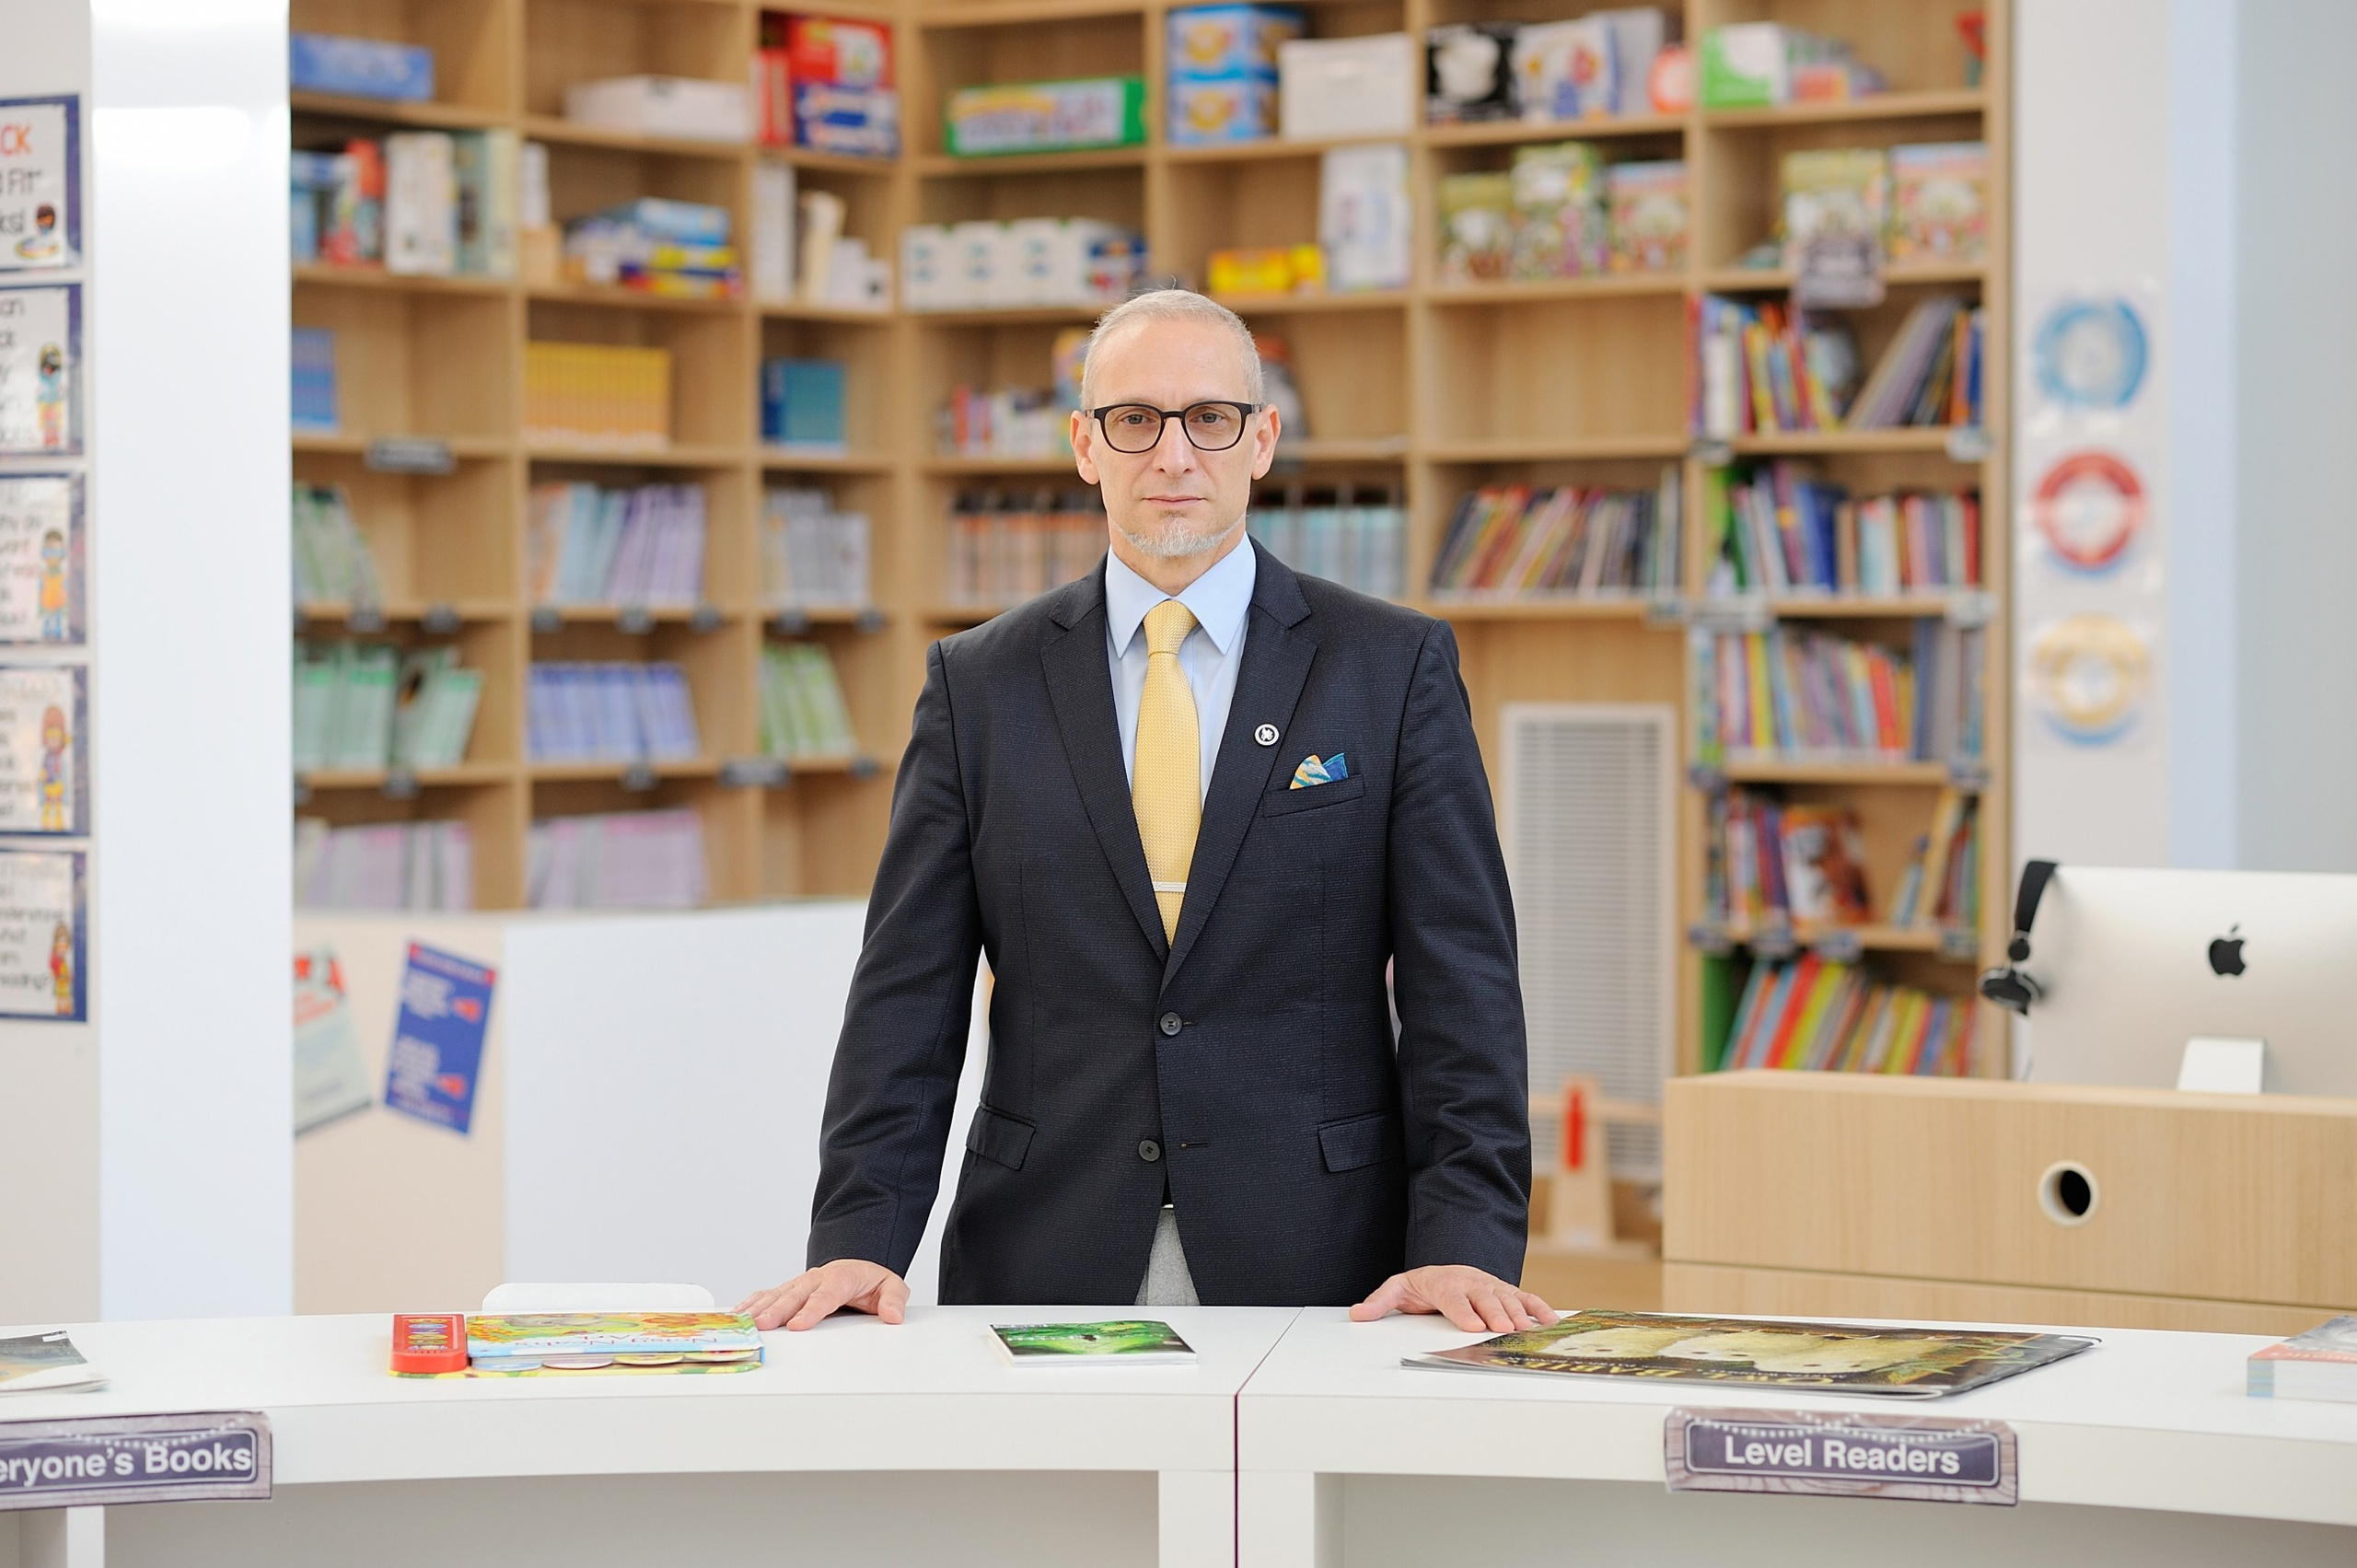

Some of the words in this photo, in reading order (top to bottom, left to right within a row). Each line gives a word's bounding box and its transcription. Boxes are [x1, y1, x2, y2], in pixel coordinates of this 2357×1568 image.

[145, 1442, 252, 1473] Books
[1724, 1435, 1812, 1467] Level
[1823, 1439, 1960, 1475] Readers
